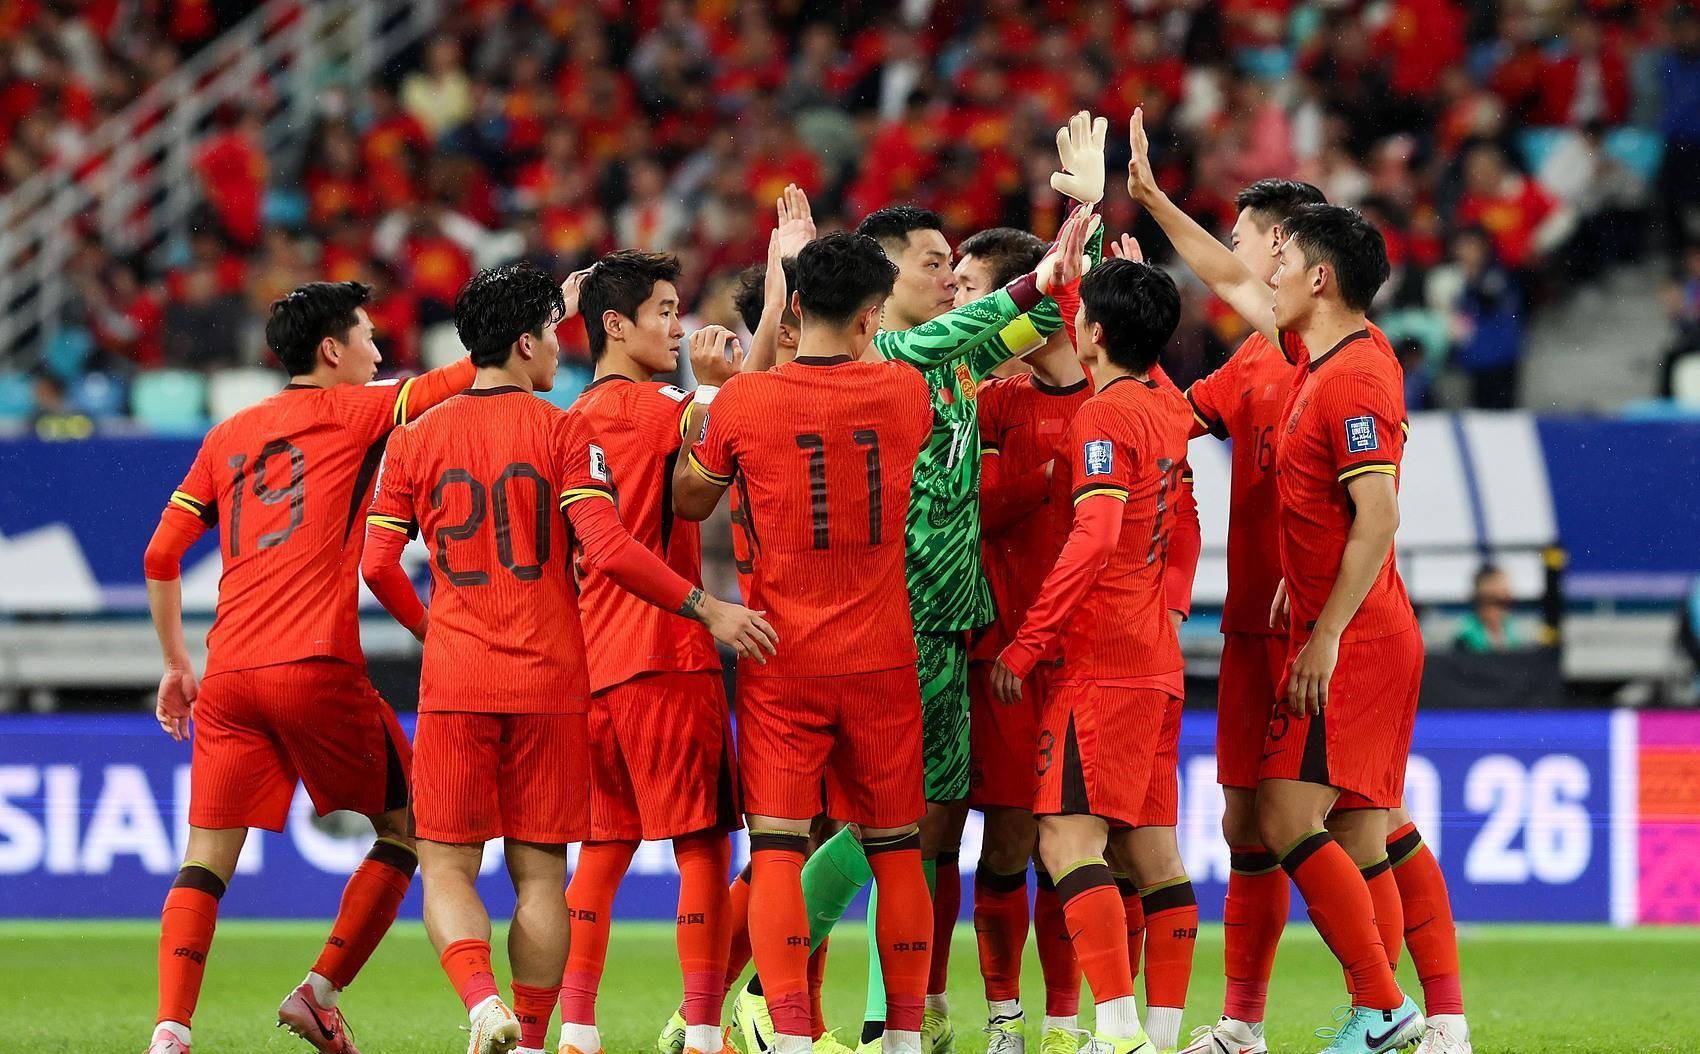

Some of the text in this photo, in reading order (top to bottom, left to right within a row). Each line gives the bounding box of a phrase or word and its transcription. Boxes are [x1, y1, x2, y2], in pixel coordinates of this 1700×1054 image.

[228, 438, 305, 558] 19
[430, 462, 551, 587] 20
[795, 429, 883, 550] 11
[1464, 753, 1594, 885] 26
